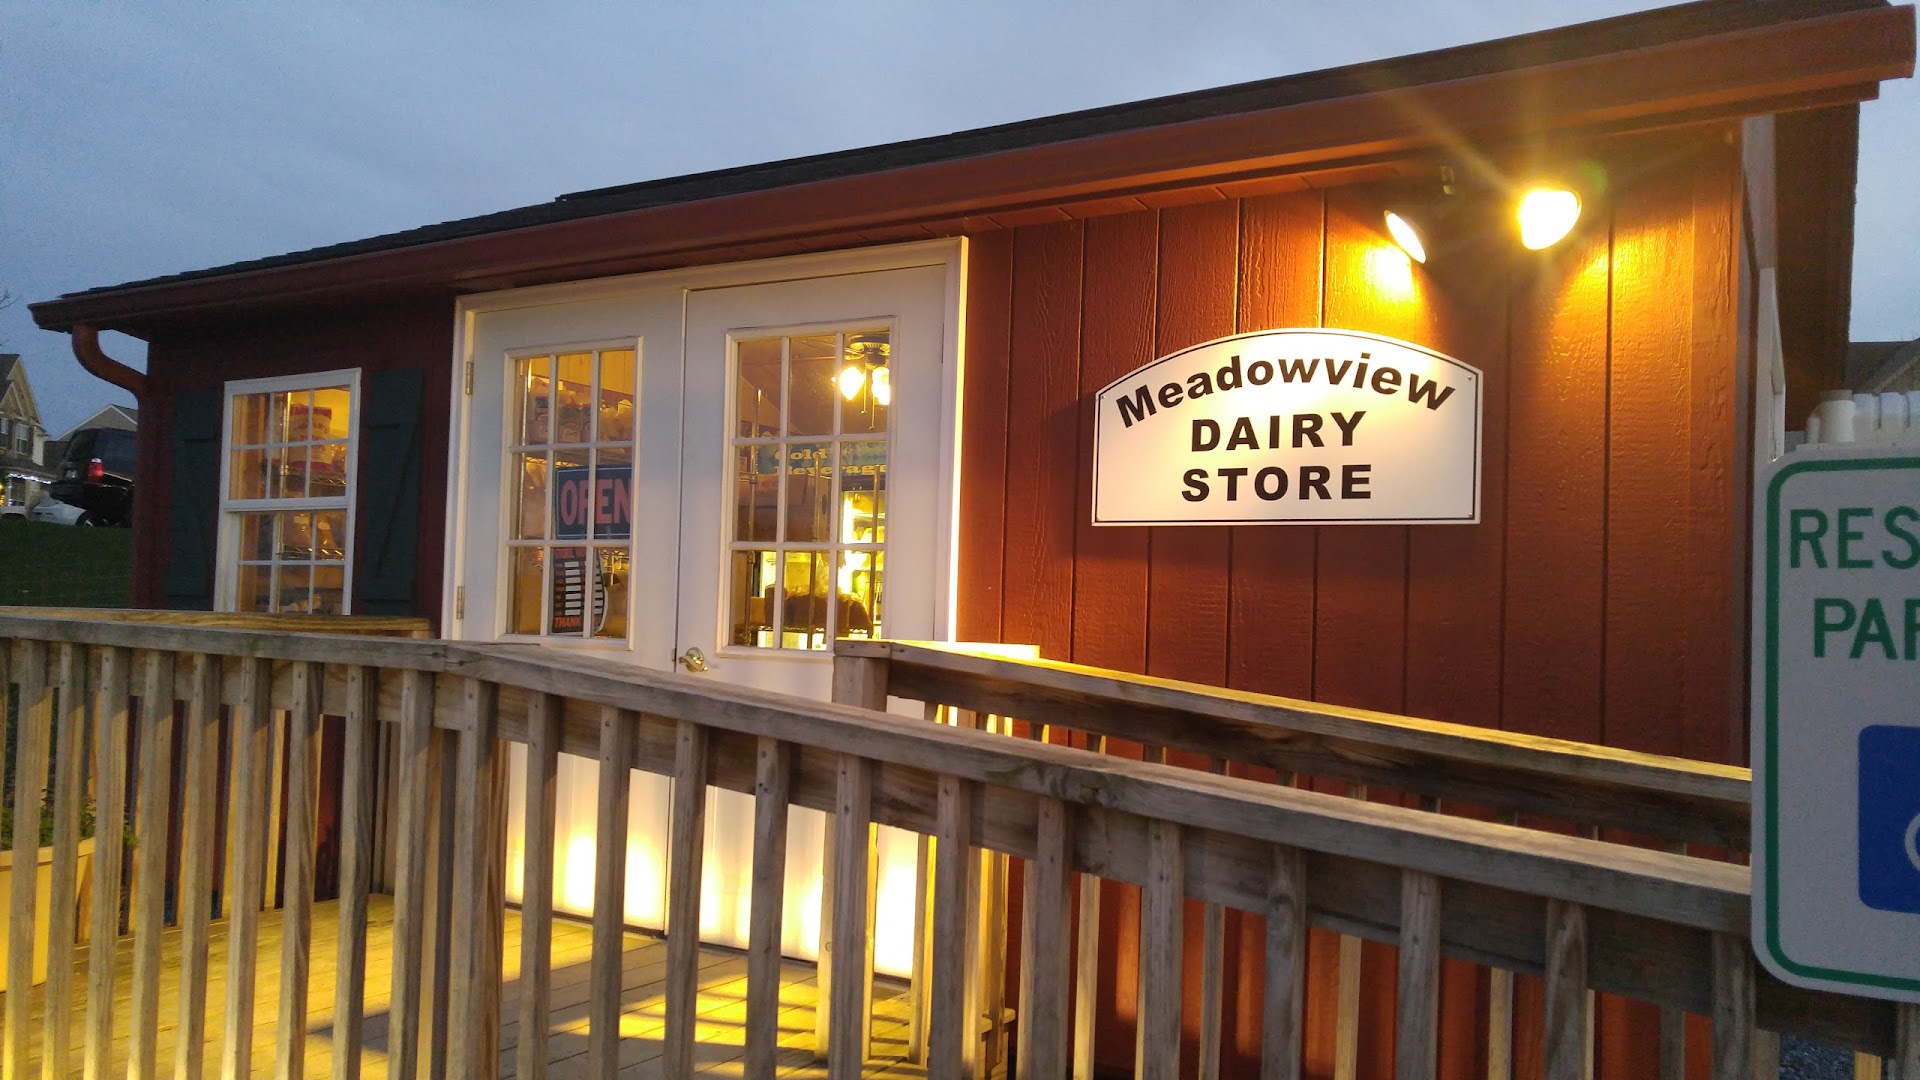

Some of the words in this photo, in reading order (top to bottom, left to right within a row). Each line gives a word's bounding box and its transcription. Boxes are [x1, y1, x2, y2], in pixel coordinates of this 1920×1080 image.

[1115, 352, 1456, 428] Meadowview
[1190, 410, 1367, 453] DAIRY
[560, 479, 632, 526] OPEN
[1181, 464, 1373, 502] STORE
[1790, 505, 1920, 570] RES
